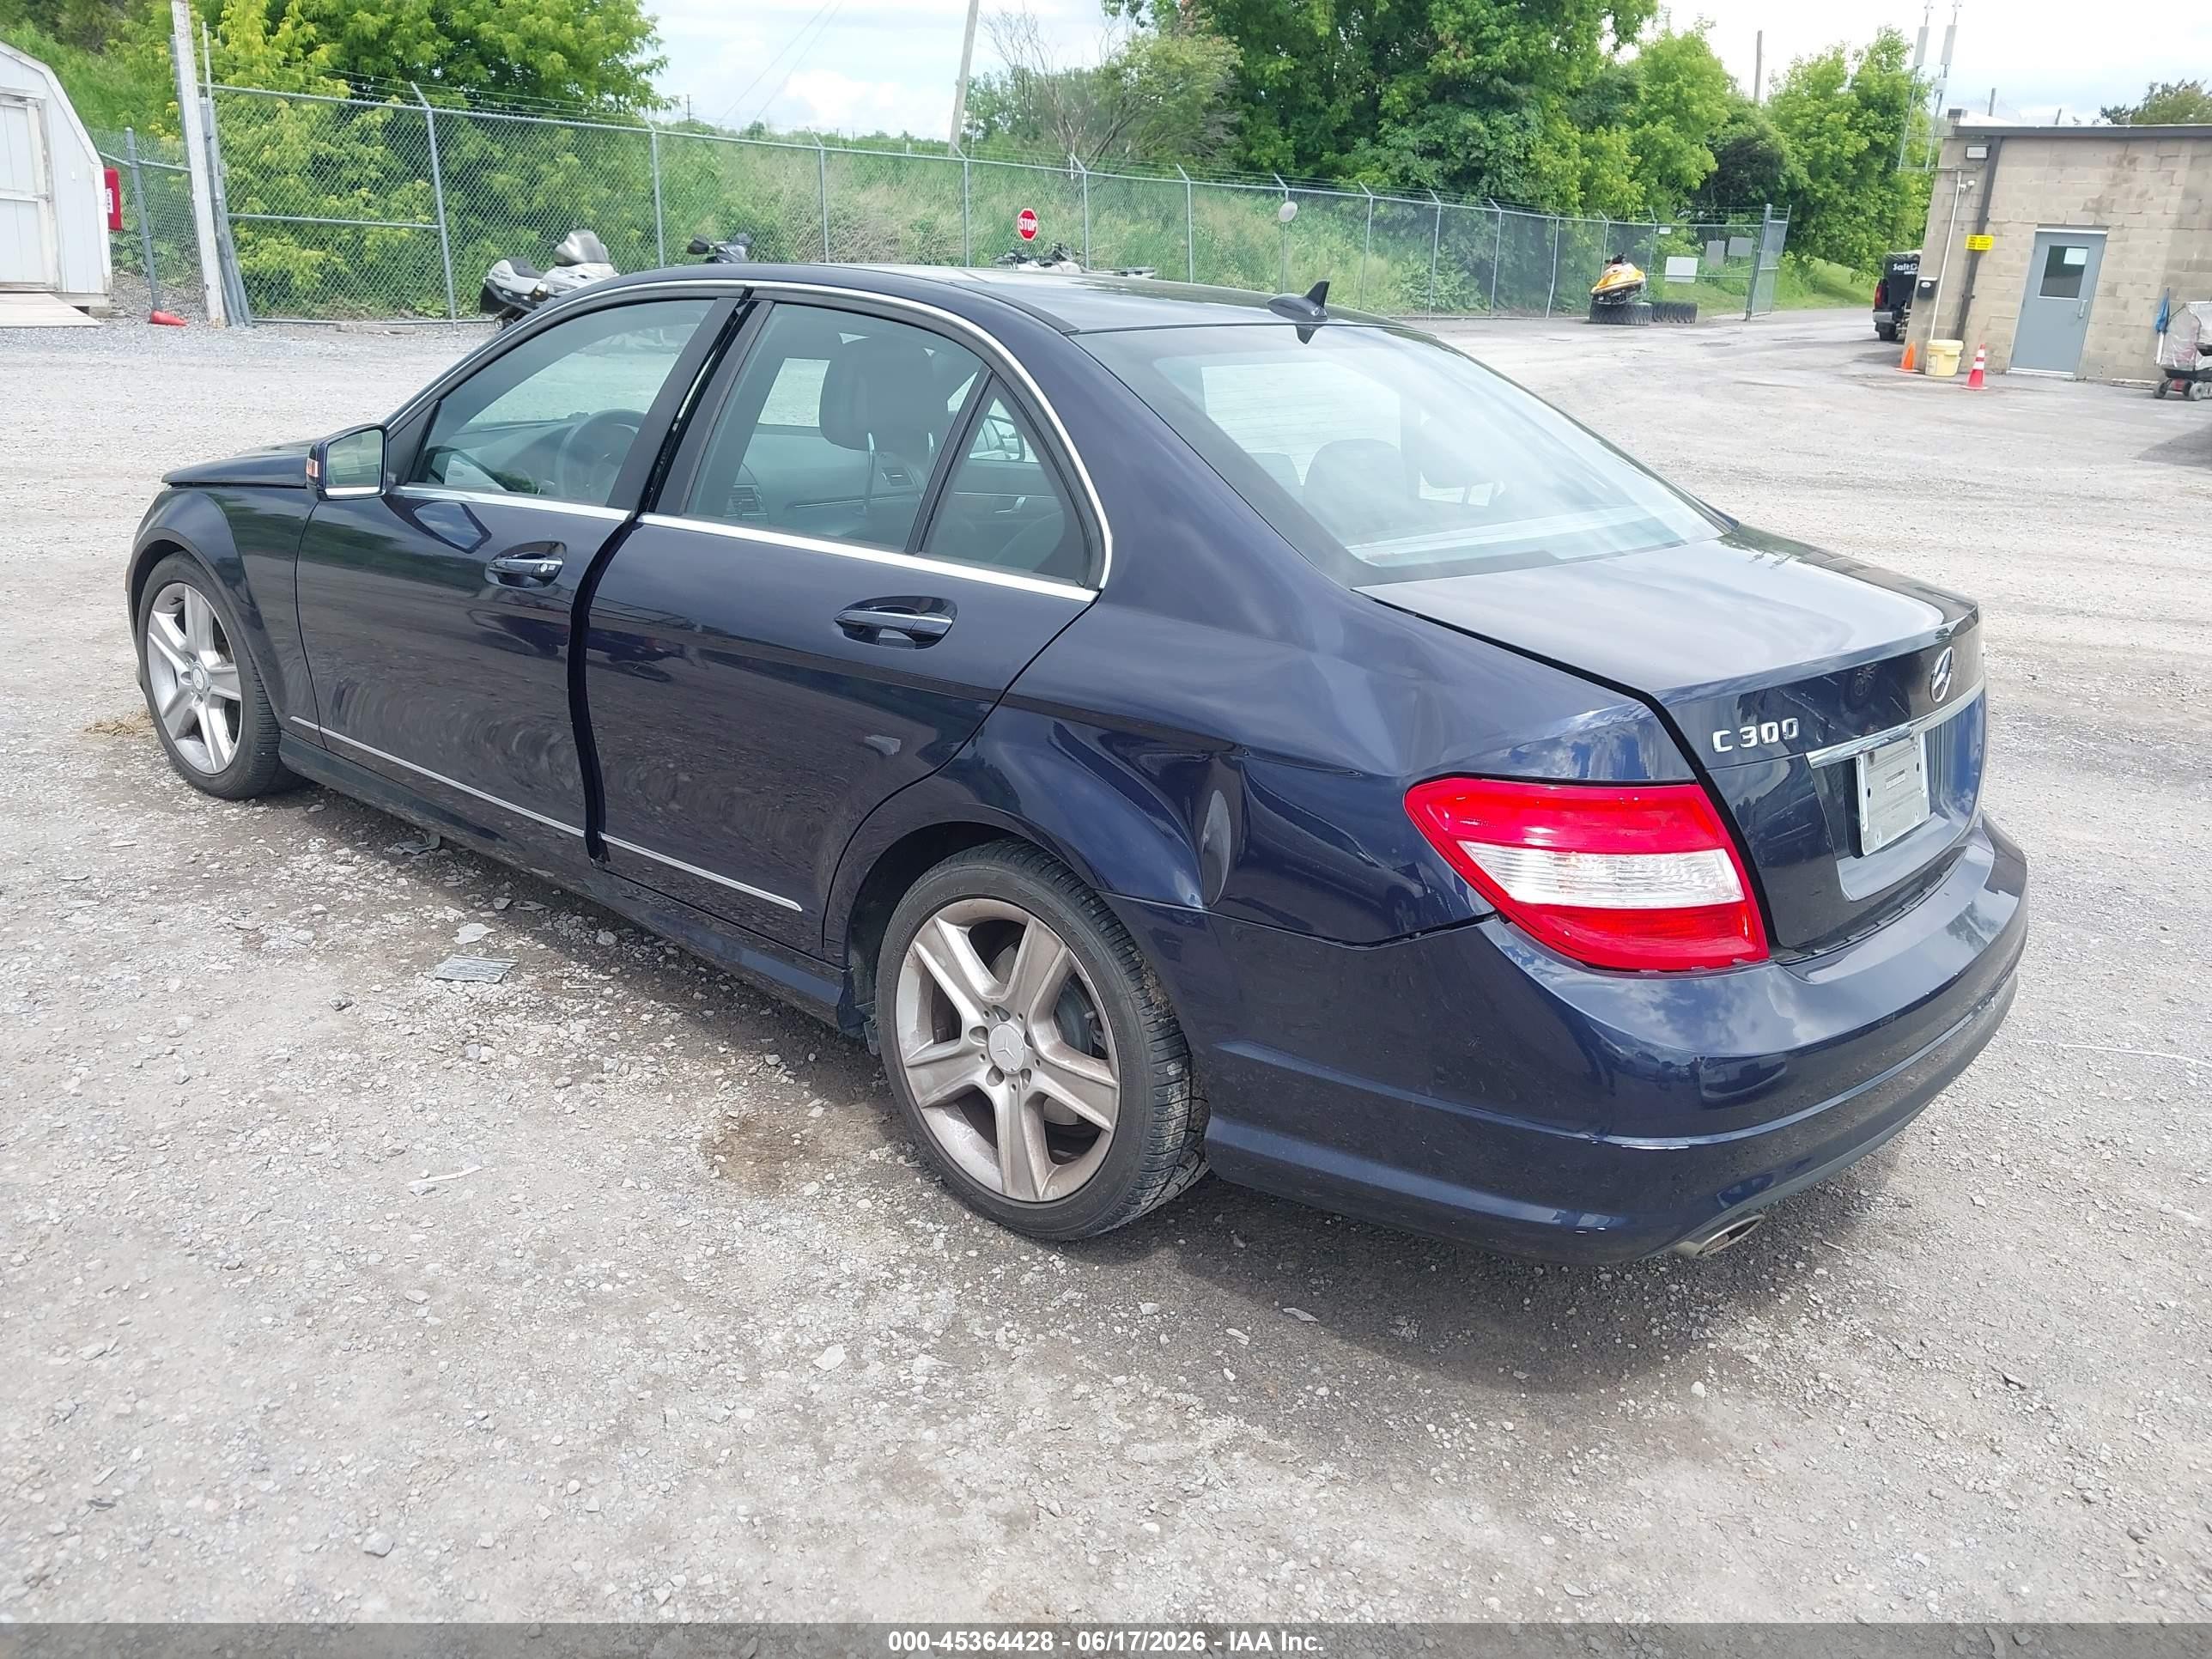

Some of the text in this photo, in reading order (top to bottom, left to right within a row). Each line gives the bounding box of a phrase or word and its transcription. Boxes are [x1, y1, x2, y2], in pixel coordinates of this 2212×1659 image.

[1019, 218, 1036, 232] STOP
[1712, 717, 1800, 753] C 300
